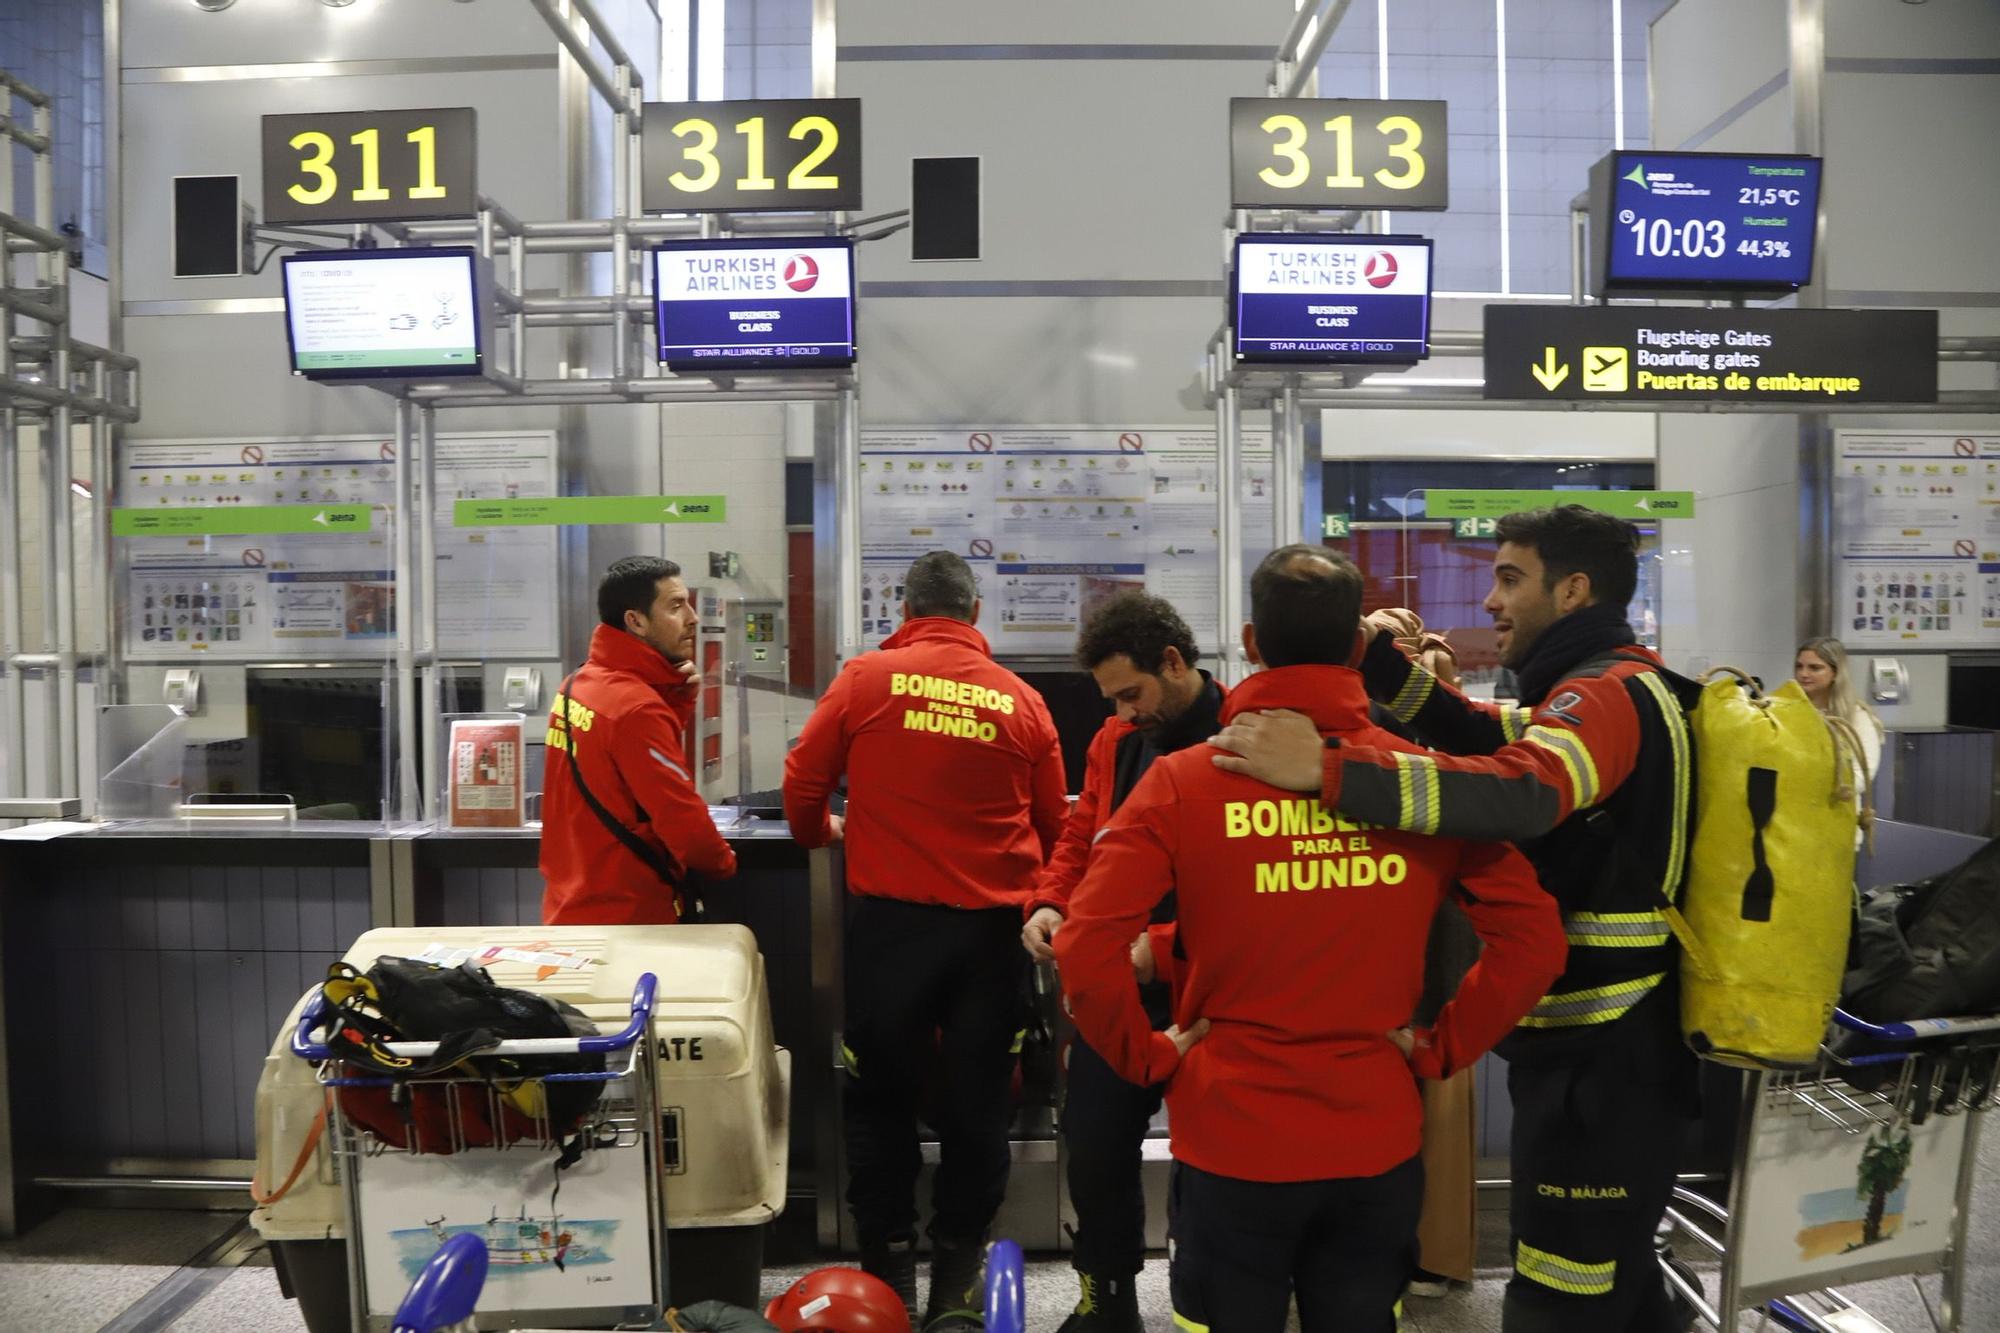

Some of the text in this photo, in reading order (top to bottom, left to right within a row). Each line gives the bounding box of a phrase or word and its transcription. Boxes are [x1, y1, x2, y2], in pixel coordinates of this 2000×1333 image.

[668, 116, 839, 192] 312
[1259, 115, 1425, 190] 313
[287, 127, 446, 205] 311
[1631, 218, 1726, 258] 10:03
[1736, 240, 1791, 258] 44,3%
[686, 258, 776, 273] TURKISH
[1268, 253, 1357, 267] TURKISH
[687, 275, 776, 291] AIRLINES
[1268, 270, 1356, 285] AIRLINES
[729, 311, 781, 320] BUSINESS
[1307, 305, 1358, 315] BUSINESS
[738, 323, 773, 332] CLASS
[1316, 318, 1349, 327] CLASS
[1270, 342, 1393, 351] STAR ALLIANCE GOLD
[1637, 328, 1772, 348] Flugsteige Gates
[693, 347, 820, 357] STAR ALLIANCE GOLD
[1637, 349, 1760, 370] Boarding gates
[1637, 371, 1860, 395] Puertas de embarque
[682, 504, 711, 513] aena
[891, 673, 1015, 715] BOMBEROS
[928, 701, 978, 719] PARA EL
[904, 709, 997, 742] MUNDO
[1225, 799, 1384, 838] BOMB
[1292, 837, 1372, 855] PARA EL
[1255, 854, 1407, 893] MUNDO
[1537, 1184, 1628, 1199] CPB MÁLAGA
